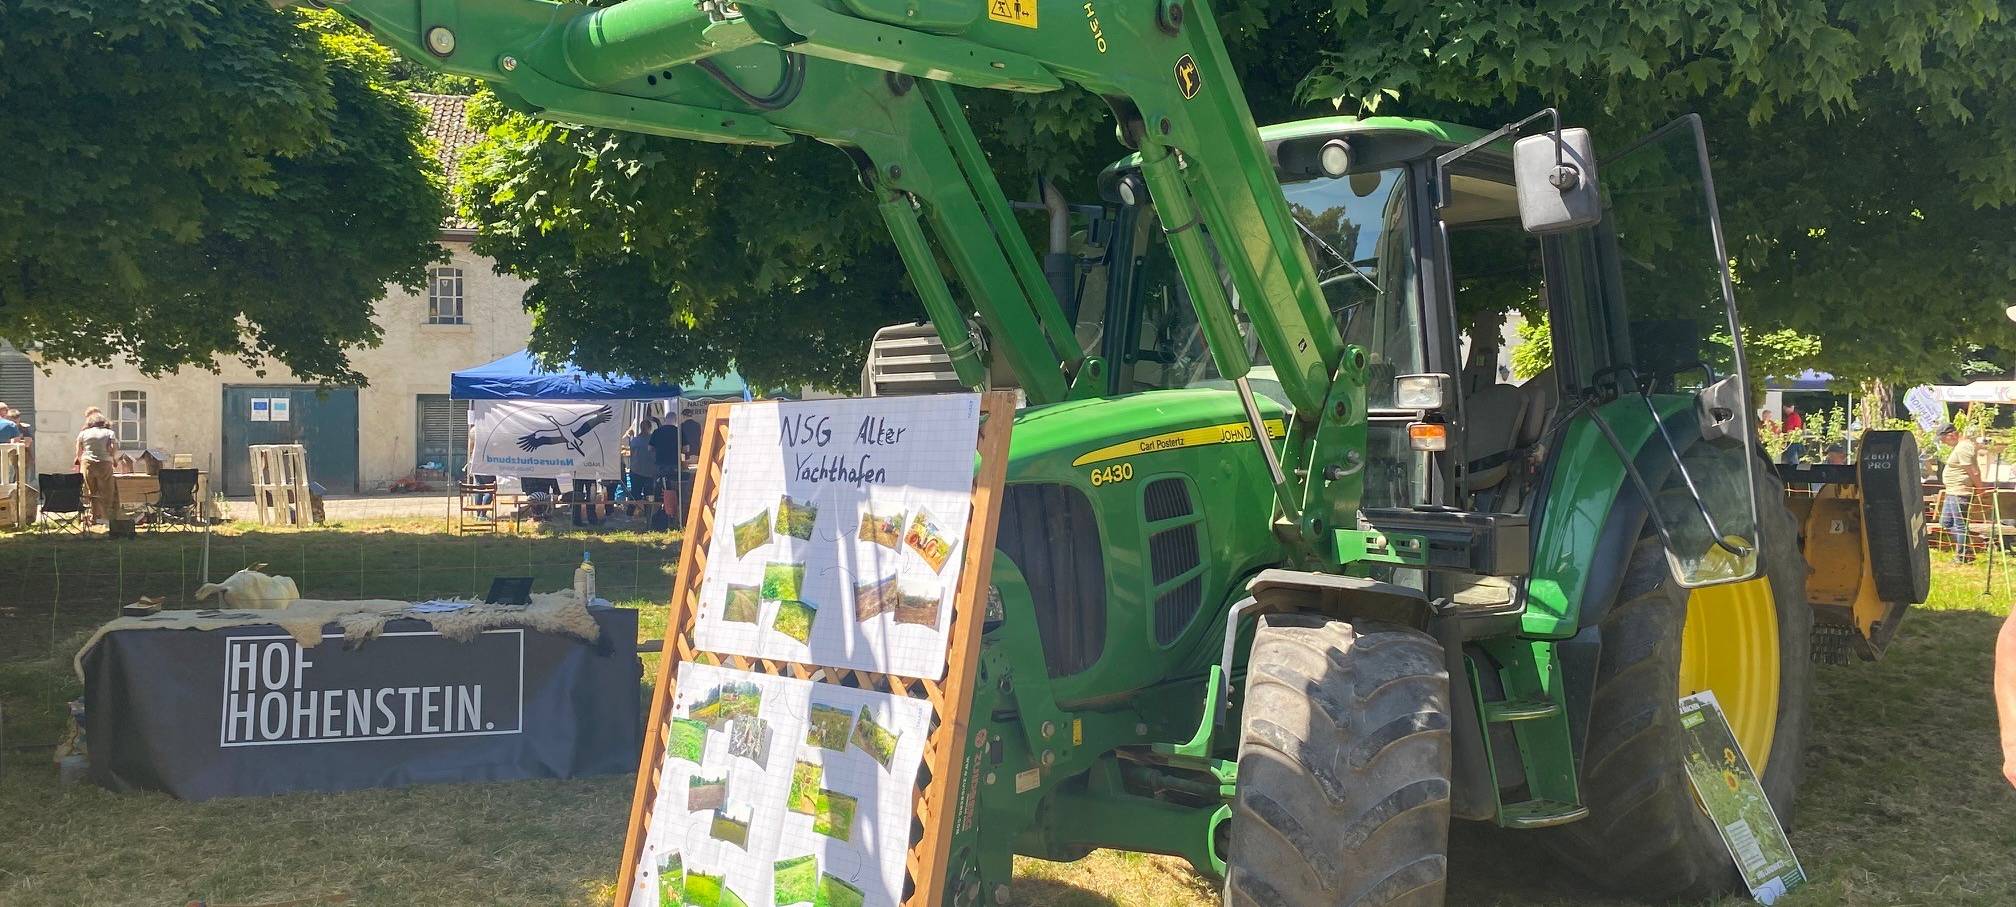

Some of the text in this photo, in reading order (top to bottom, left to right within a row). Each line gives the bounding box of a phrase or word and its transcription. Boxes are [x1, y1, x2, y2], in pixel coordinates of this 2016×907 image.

[1083, 2, 1107, 53] H 310
[778, 413, 907, 447] NSG Alter
[1140, 441, 1155, 452] Carl
[1156, 437, 1185, 449] Postertz
[1220, 429, 1244, 443] JOHN
[795, 452, 886, 488] Yachthafen
[1090, 463, 1134, 488] 6430
[231, 642, 313, 691] HOF
[228, 684, 495, 741] HOHENSTEIN.
